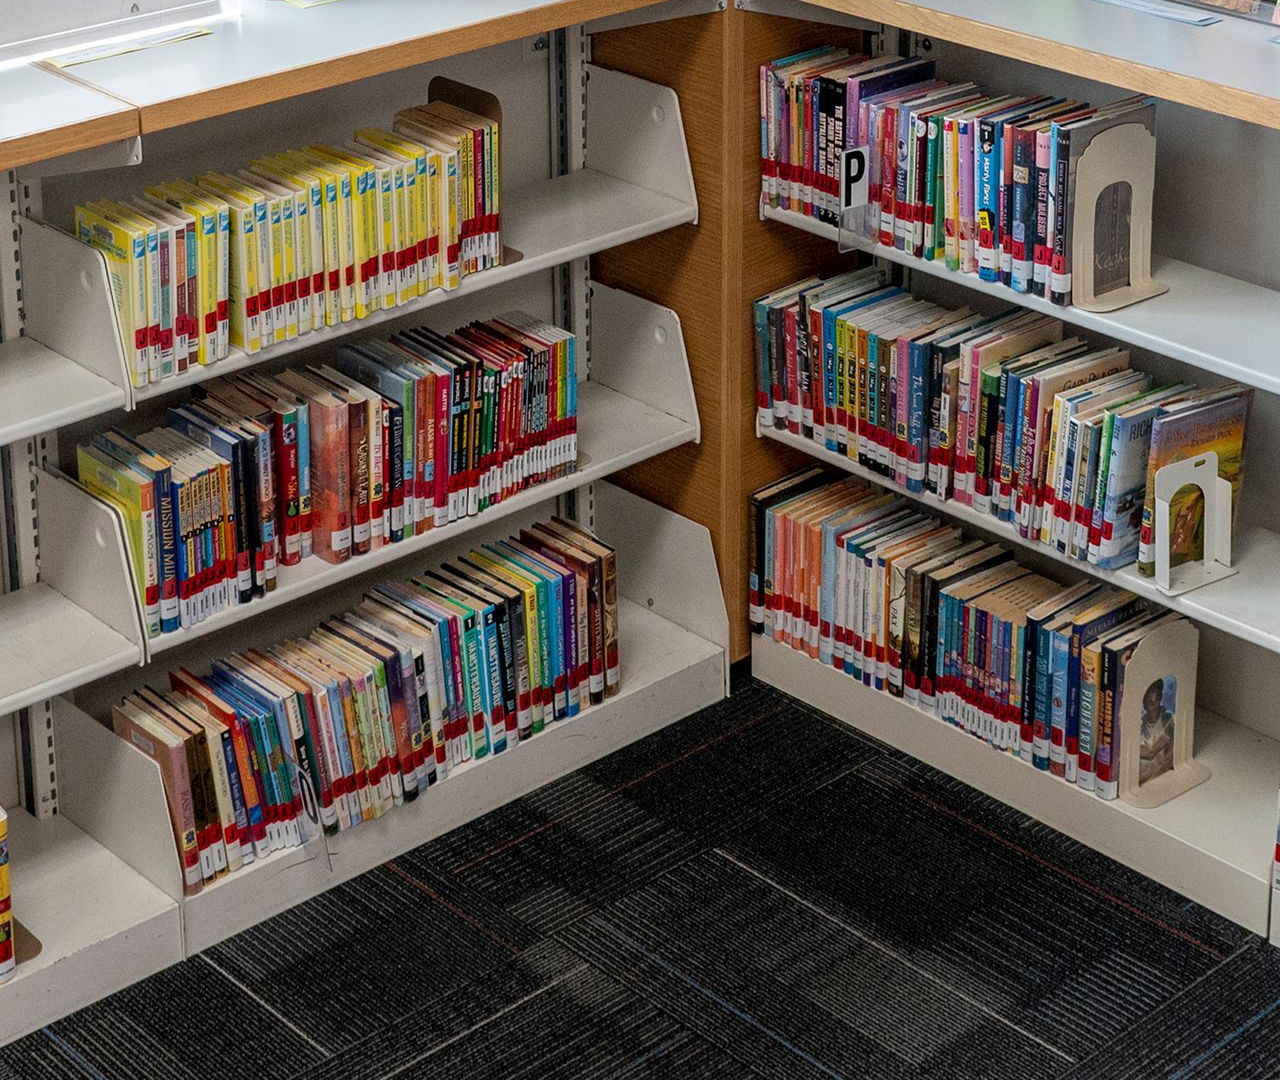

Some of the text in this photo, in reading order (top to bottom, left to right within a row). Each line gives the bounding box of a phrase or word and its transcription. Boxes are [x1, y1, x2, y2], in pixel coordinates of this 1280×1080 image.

[844, 150, 865, 208] P
[1037, 172, 1048, 237] PROJECT MULBERRY
[161, 497, 175, 550] MISSION
